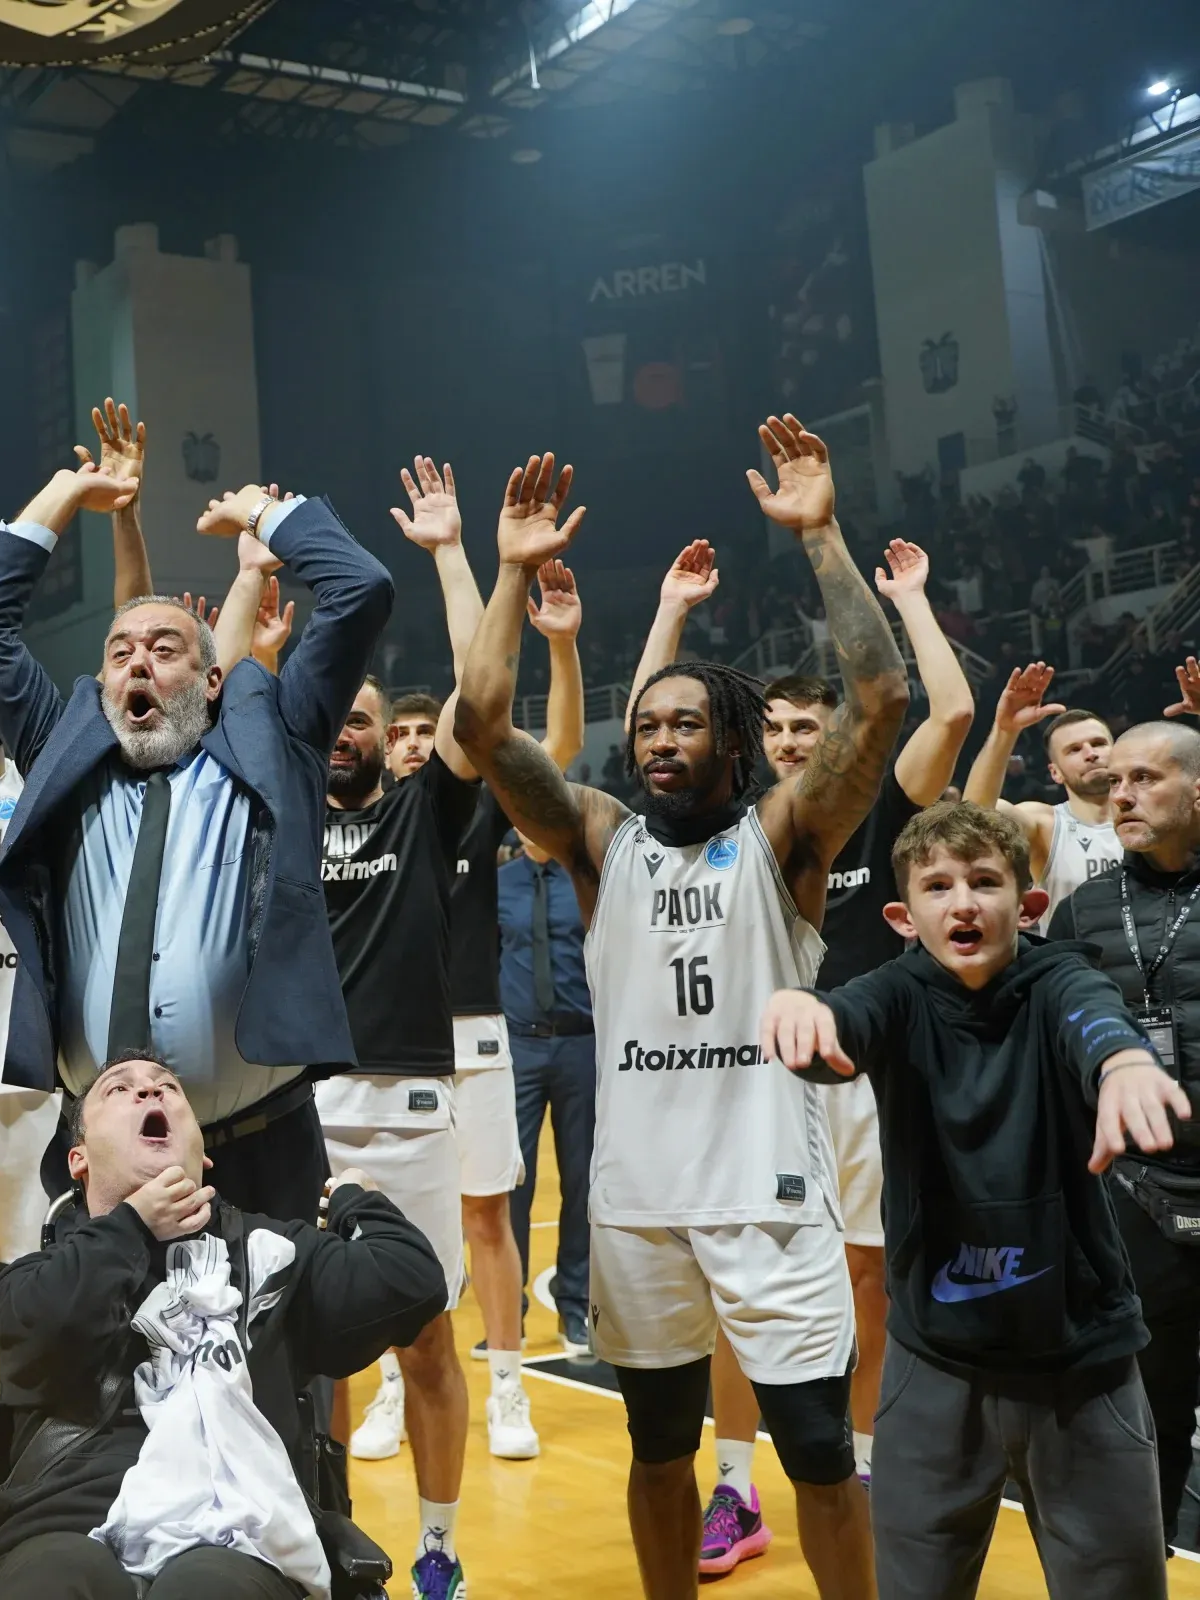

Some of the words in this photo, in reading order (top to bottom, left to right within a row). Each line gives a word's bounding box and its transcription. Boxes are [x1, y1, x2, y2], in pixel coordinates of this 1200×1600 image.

[320, 853, 397, 881] iximan
[650, 882, 724, 926] PAOK
[668, 955, 715, 1016] 16
[951, 1242, 1025, 1281] NIKE
